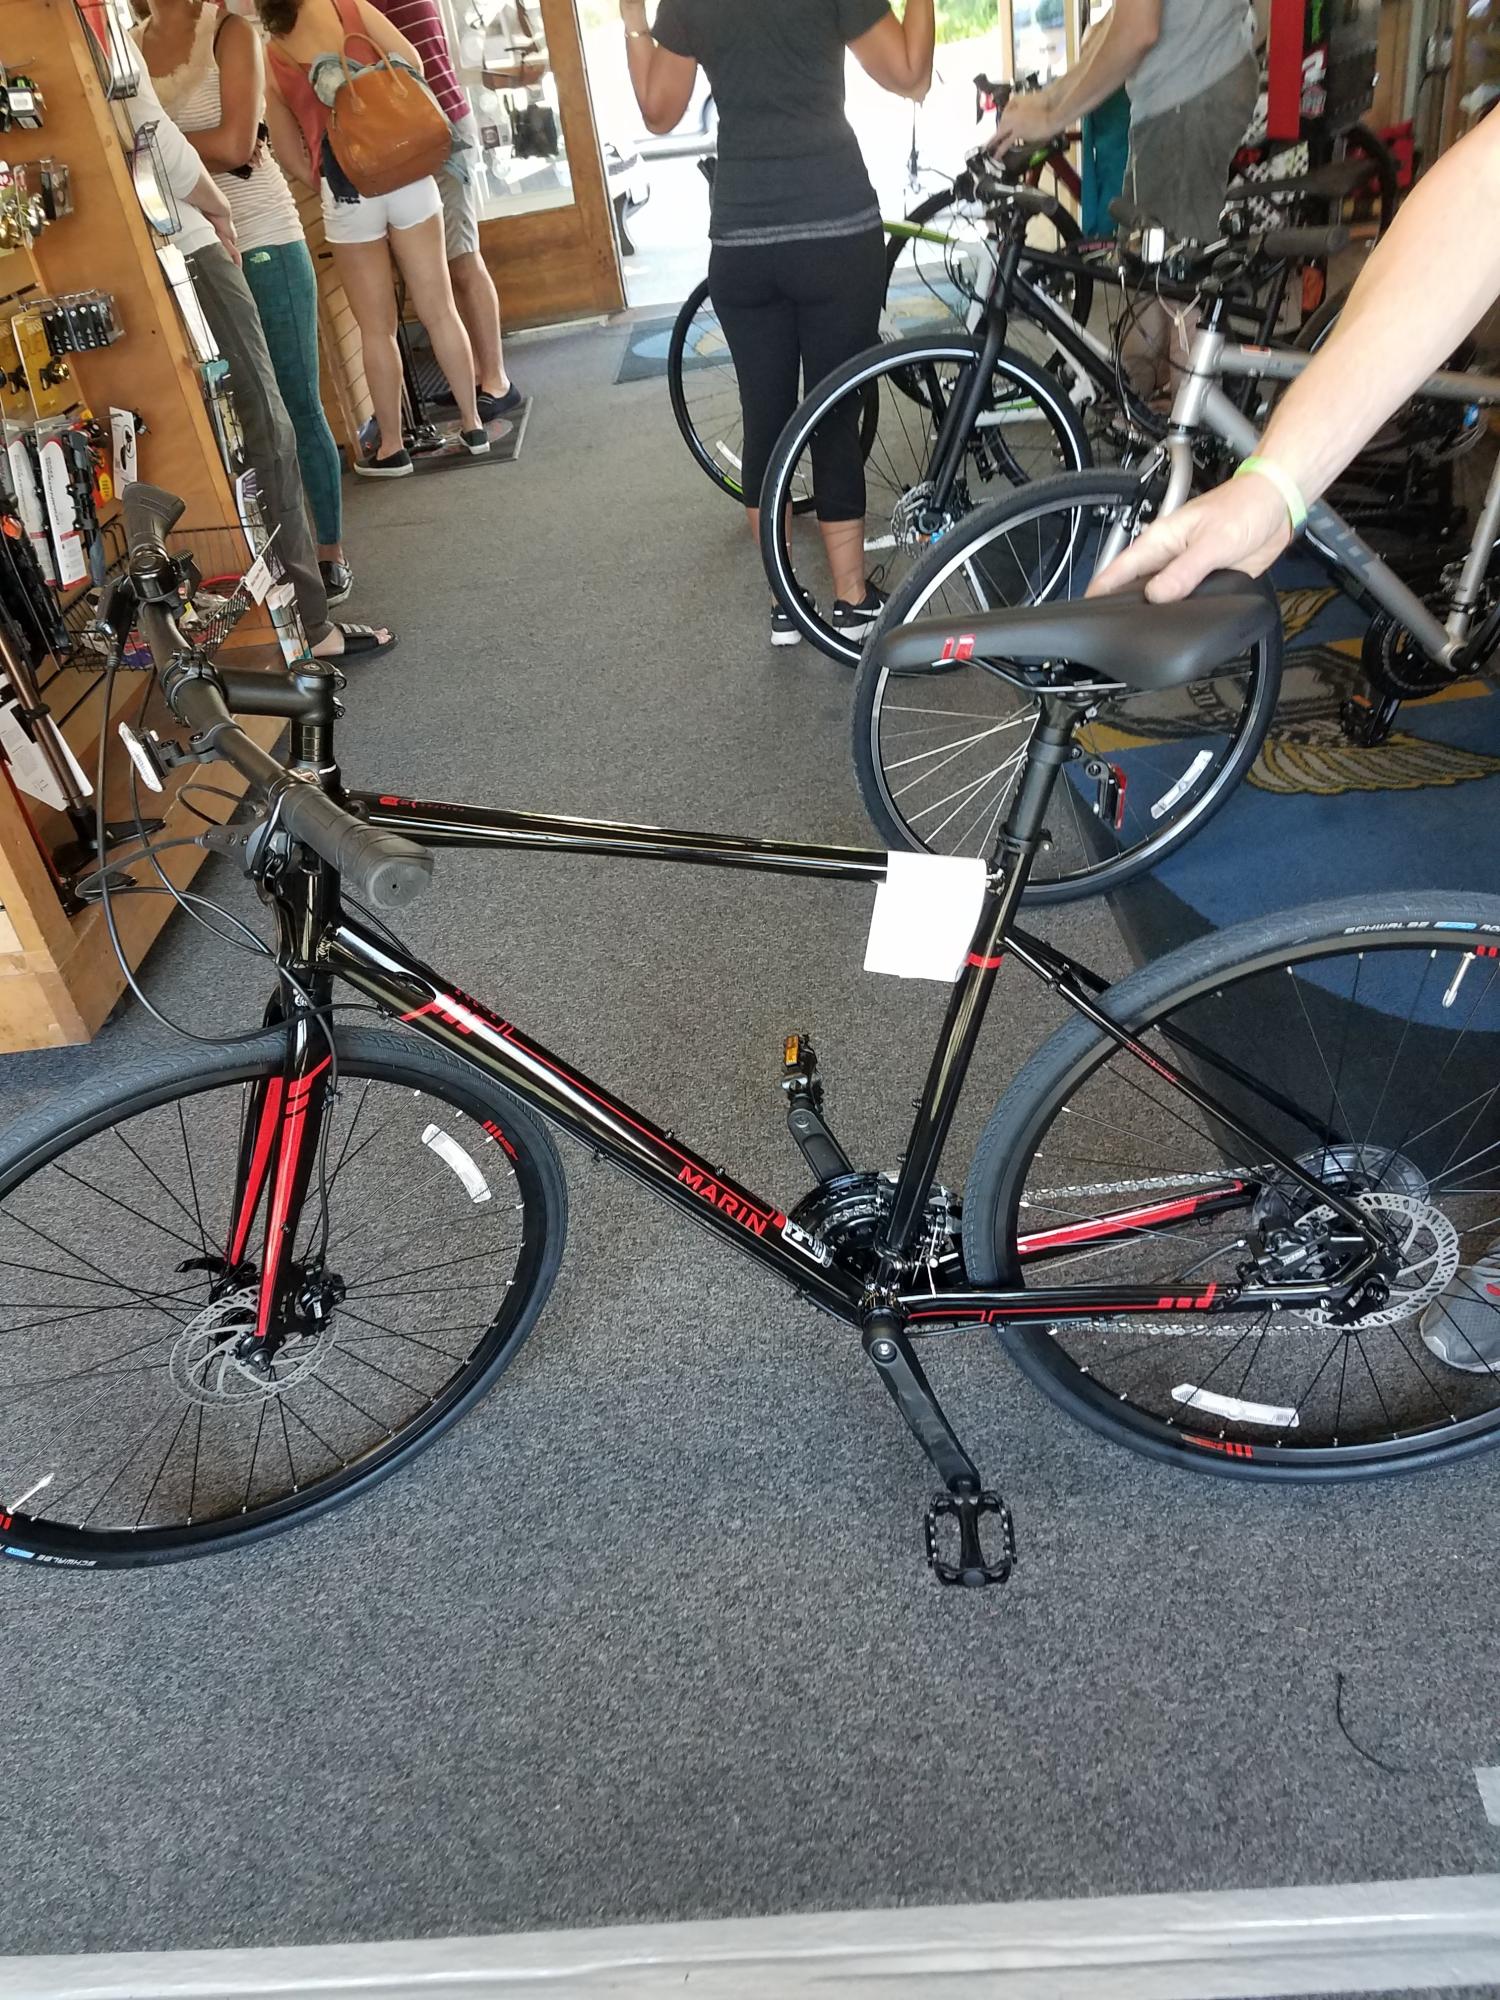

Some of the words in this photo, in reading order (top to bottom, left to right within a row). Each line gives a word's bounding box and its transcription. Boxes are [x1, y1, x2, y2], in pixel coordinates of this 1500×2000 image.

[1343, 921, 1430, 935] SCHWALBE
[678, 1165, 768, 1236] MARIN
[36, 1554, 97, 1567] SCHWALBE
